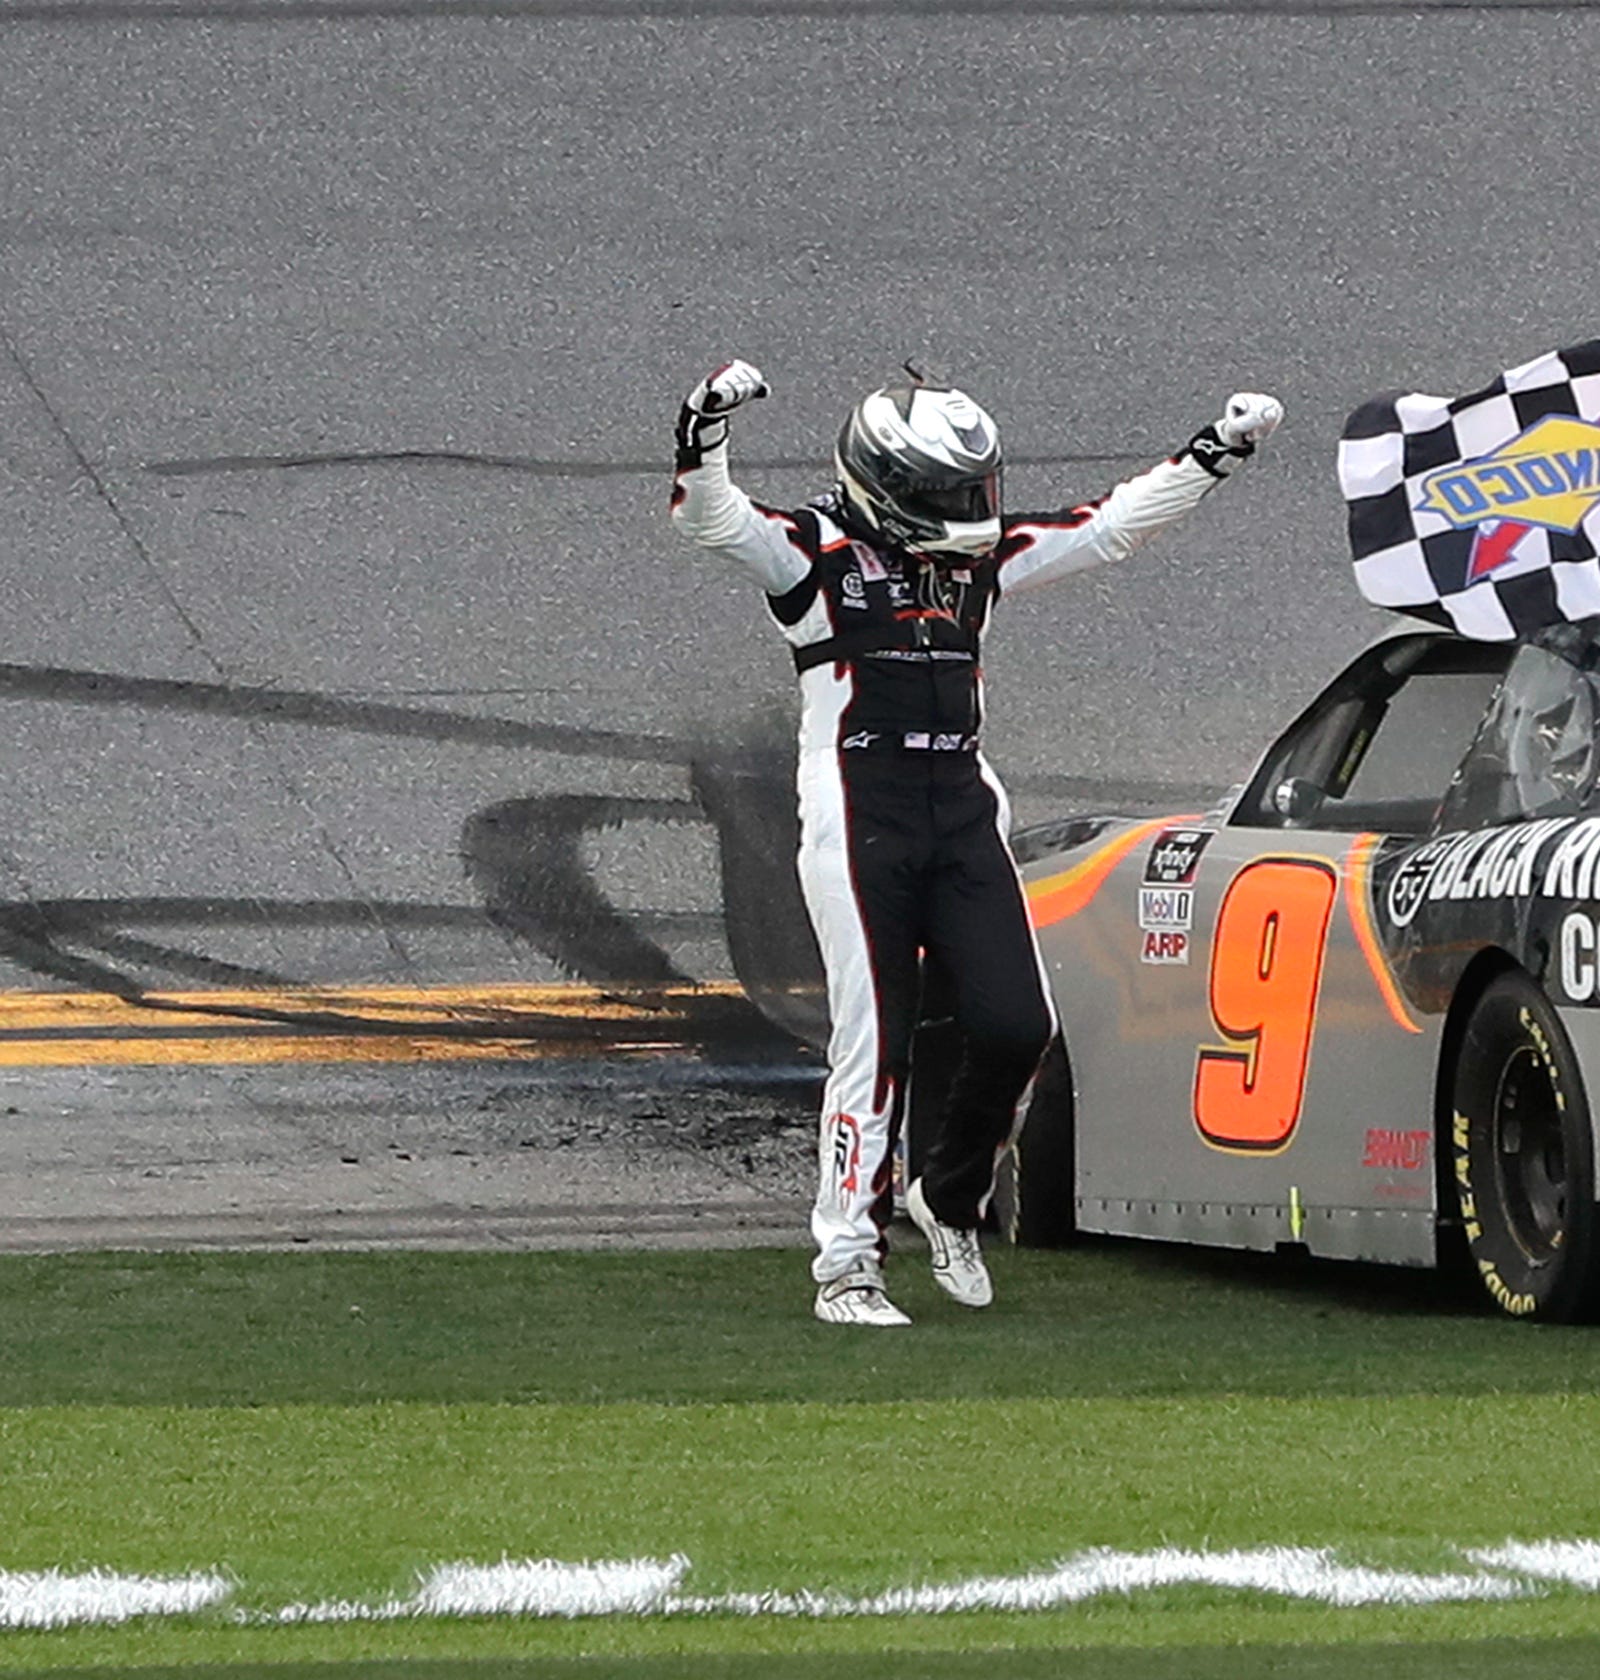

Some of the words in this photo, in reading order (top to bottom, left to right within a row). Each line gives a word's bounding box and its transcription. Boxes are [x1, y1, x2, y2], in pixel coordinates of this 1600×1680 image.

[1429, 817, 1576, 900] BLACK
[1144, 931, 1187, 958] ARP
[1190, 852, 1341, 1157] 9
